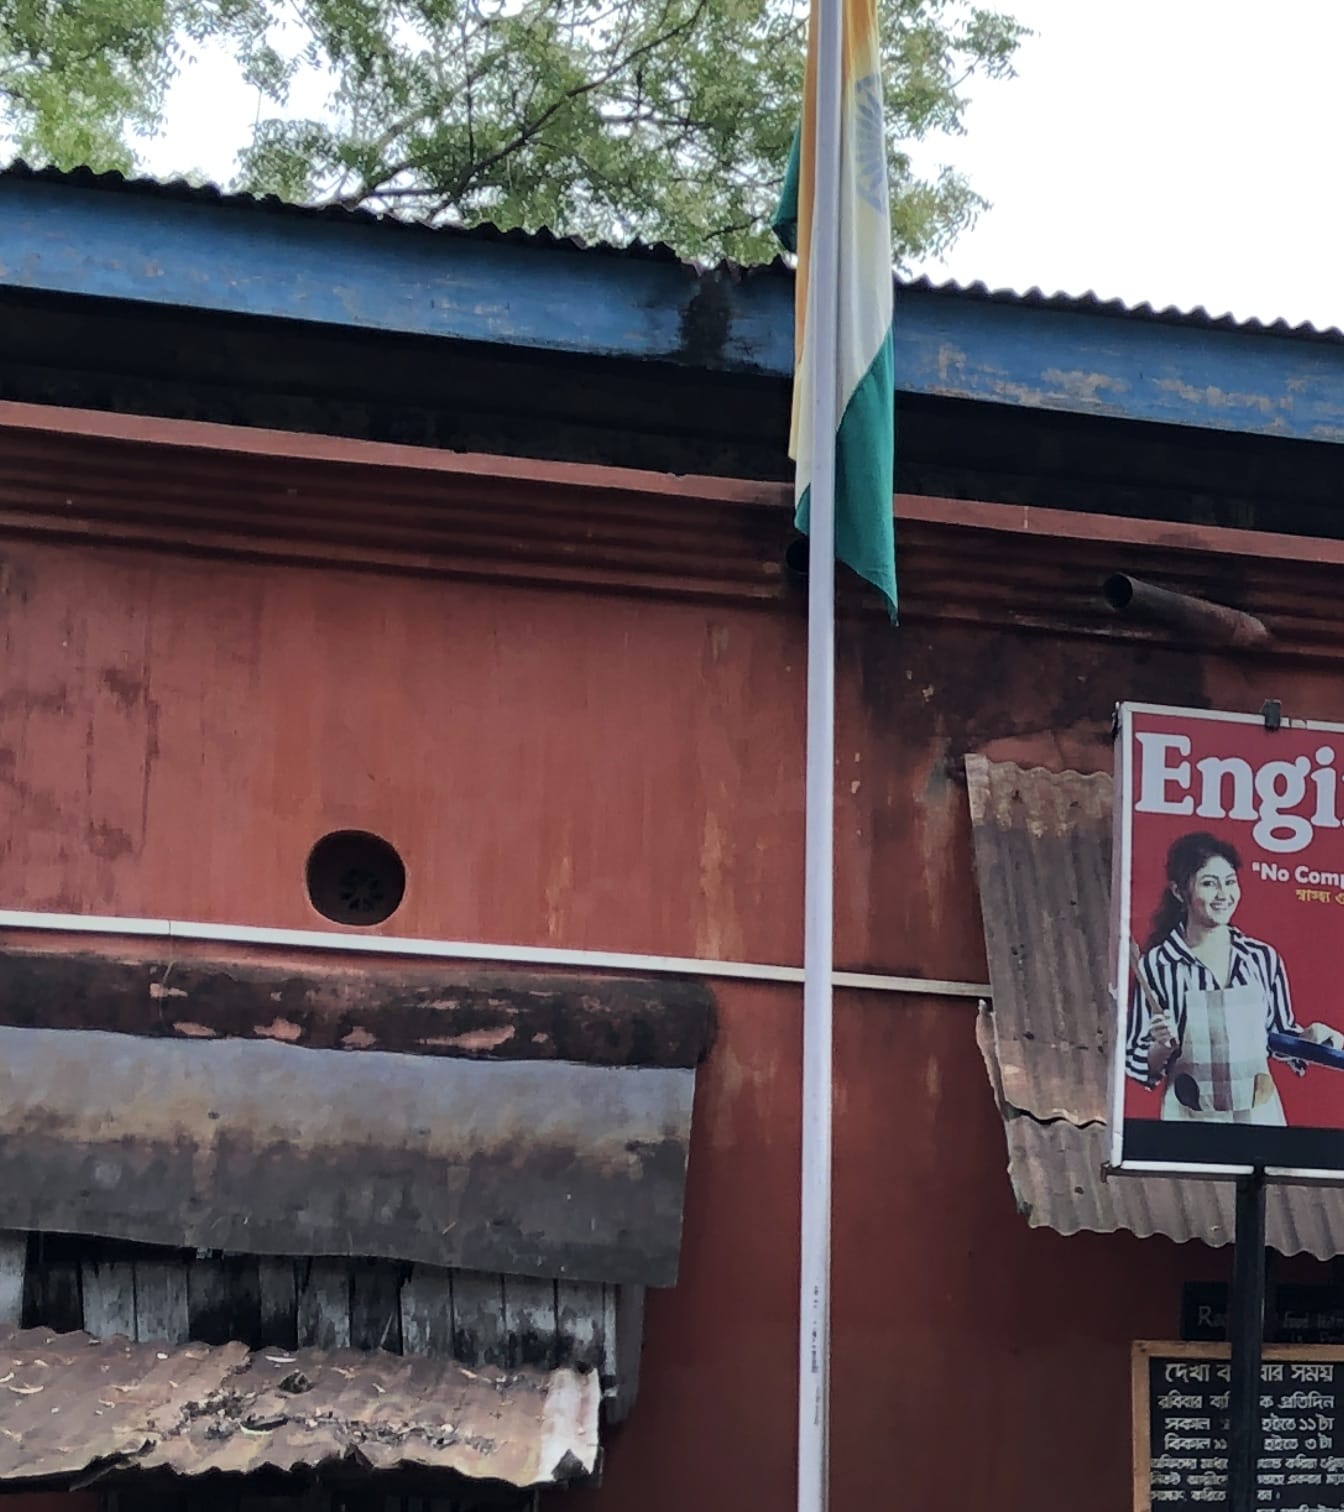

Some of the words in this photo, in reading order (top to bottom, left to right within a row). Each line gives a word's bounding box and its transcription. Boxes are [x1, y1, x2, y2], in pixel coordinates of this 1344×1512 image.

[1165, 1363, 1210, 1383] দেখা
[1291, 1364, 1334, 1382] সময়
[1278, 1391, 1334, 1410] প্রতিদিন
[1164, 1417, 1211, 1431] সকাল
[1164, 1432, 1211, 1451] বিকাল
